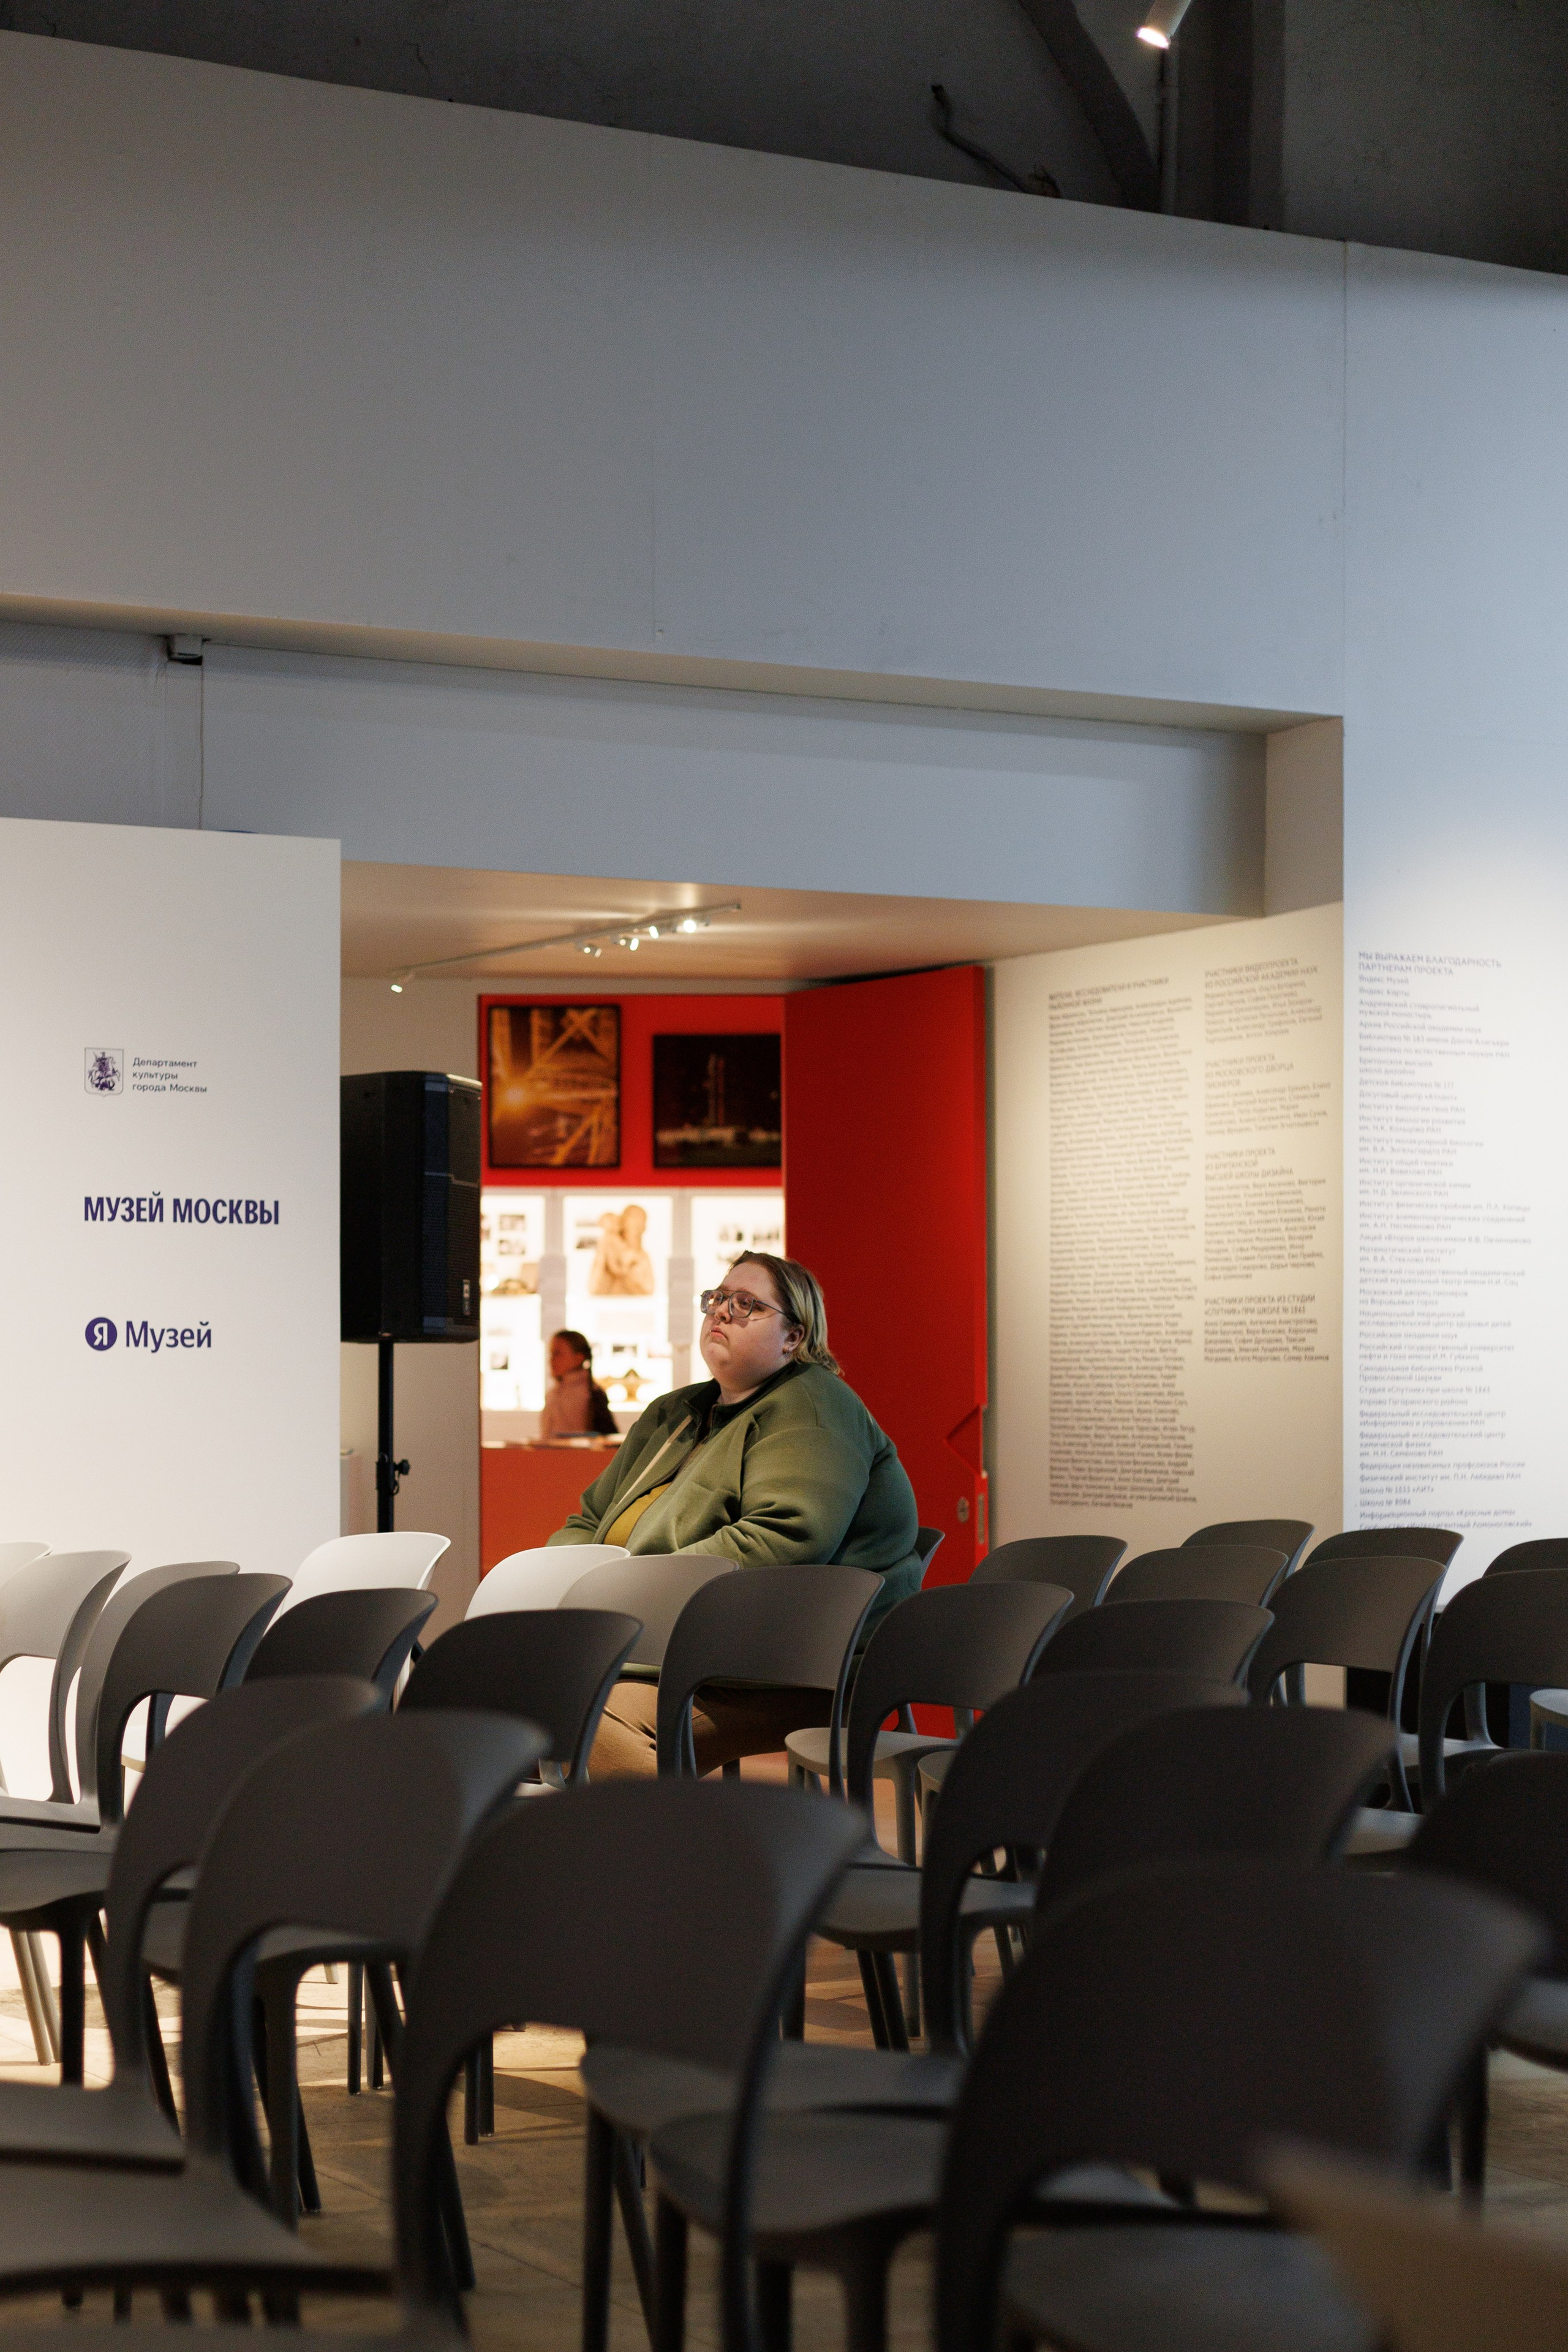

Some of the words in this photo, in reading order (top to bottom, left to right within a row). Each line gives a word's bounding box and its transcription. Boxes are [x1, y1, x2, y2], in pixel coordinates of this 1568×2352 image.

[133, 1058, 197, 1068] Департамент
[133, 1072, 178, 1081] культуры
[170, 1084, 207, 1093] Москвы
[85, 1191, 164, 1223] МУЗЕЙ
[173, 1199, 279, 1225] МОСКВЫ
[126, 1321, 211, 1353] Музей
